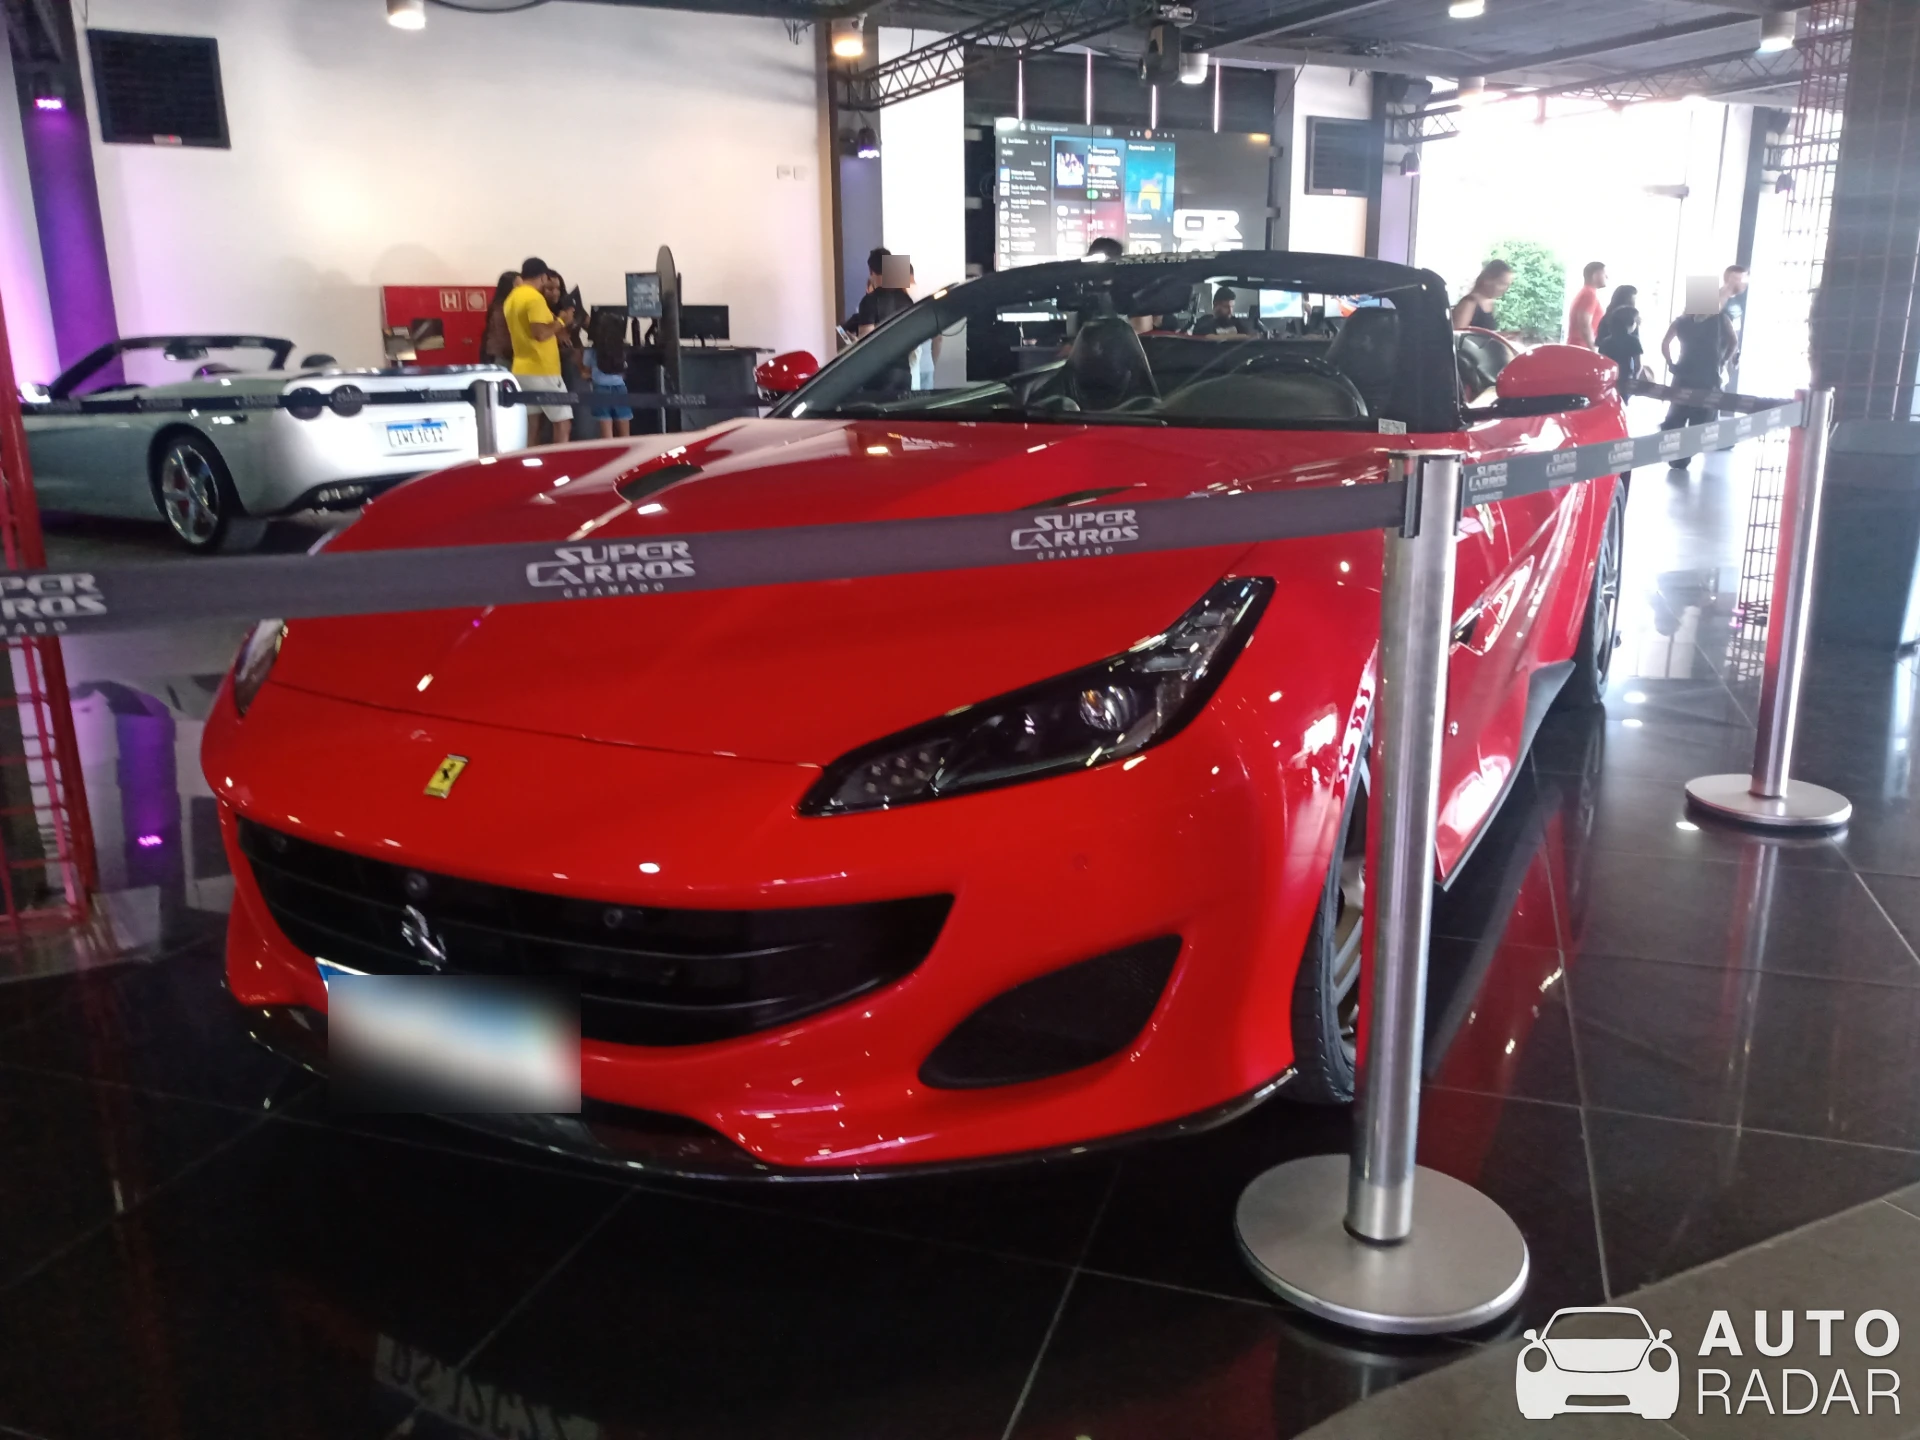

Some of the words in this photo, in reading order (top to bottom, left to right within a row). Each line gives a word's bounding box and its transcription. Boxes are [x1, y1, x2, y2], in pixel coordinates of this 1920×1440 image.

[1034, 509, 1137, 530] SUPER
[1011, 525, 1139, 550] CARROS
[555, 541, 692, 565] SUPER
[526, 559, 696, 587] CARROS
